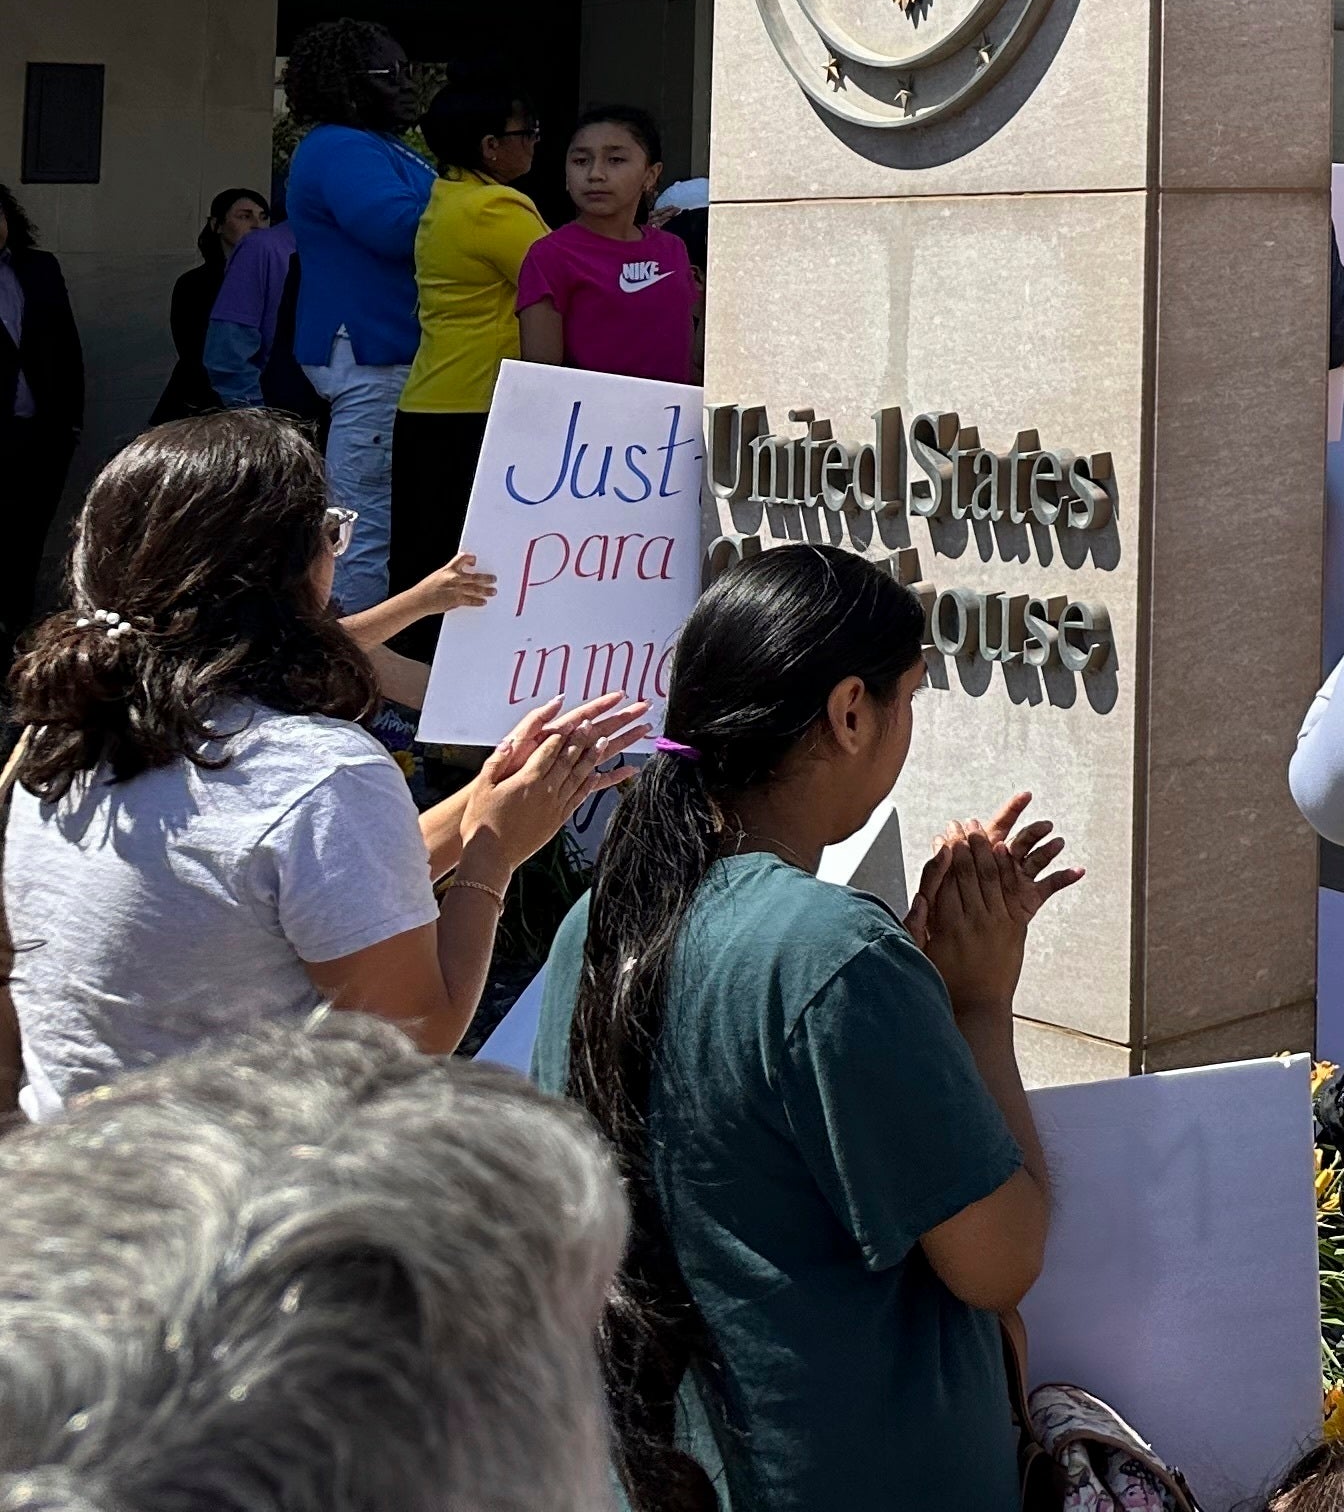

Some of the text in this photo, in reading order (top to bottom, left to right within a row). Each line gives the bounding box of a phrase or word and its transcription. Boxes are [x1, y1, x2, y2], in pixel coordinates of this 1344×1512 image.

[622, 261, 660, 281] NIKE
[505, 401, 702, 505] Just
[704, 403, 1112, 529] United States
[515, 533, 677, 617] para
